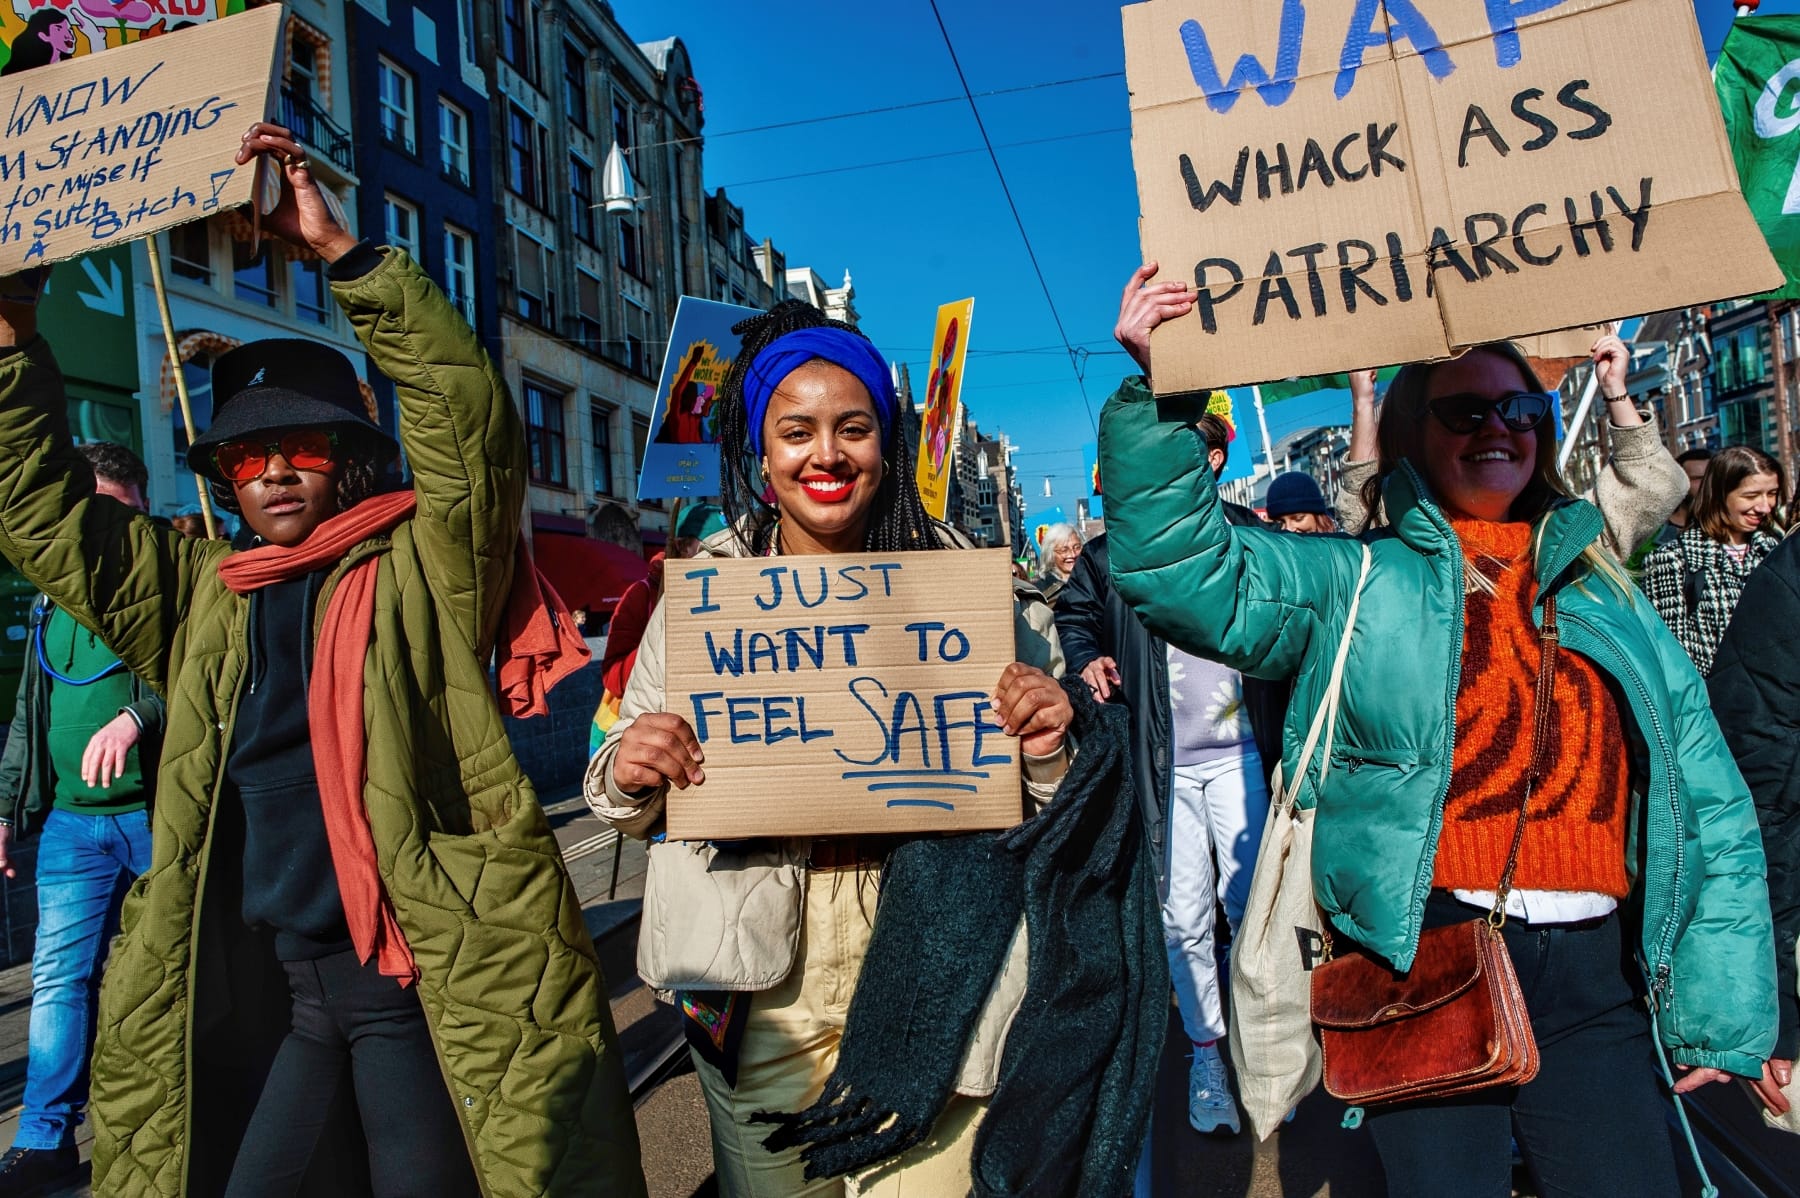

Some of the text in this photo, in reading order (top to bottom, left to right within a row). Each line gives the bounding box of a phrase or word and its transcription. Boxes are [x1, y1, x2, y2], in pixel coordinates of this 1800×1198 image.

[1179, 79, 1613, 213] WHACK ASS
[1194, 176, 1653, 334] PATRIARCHY
[685, 563, 903, 614] I JUST
[704, 622, 970, 677] WANT TO
[690, 677, 1012, 773] FEEL SAFE
